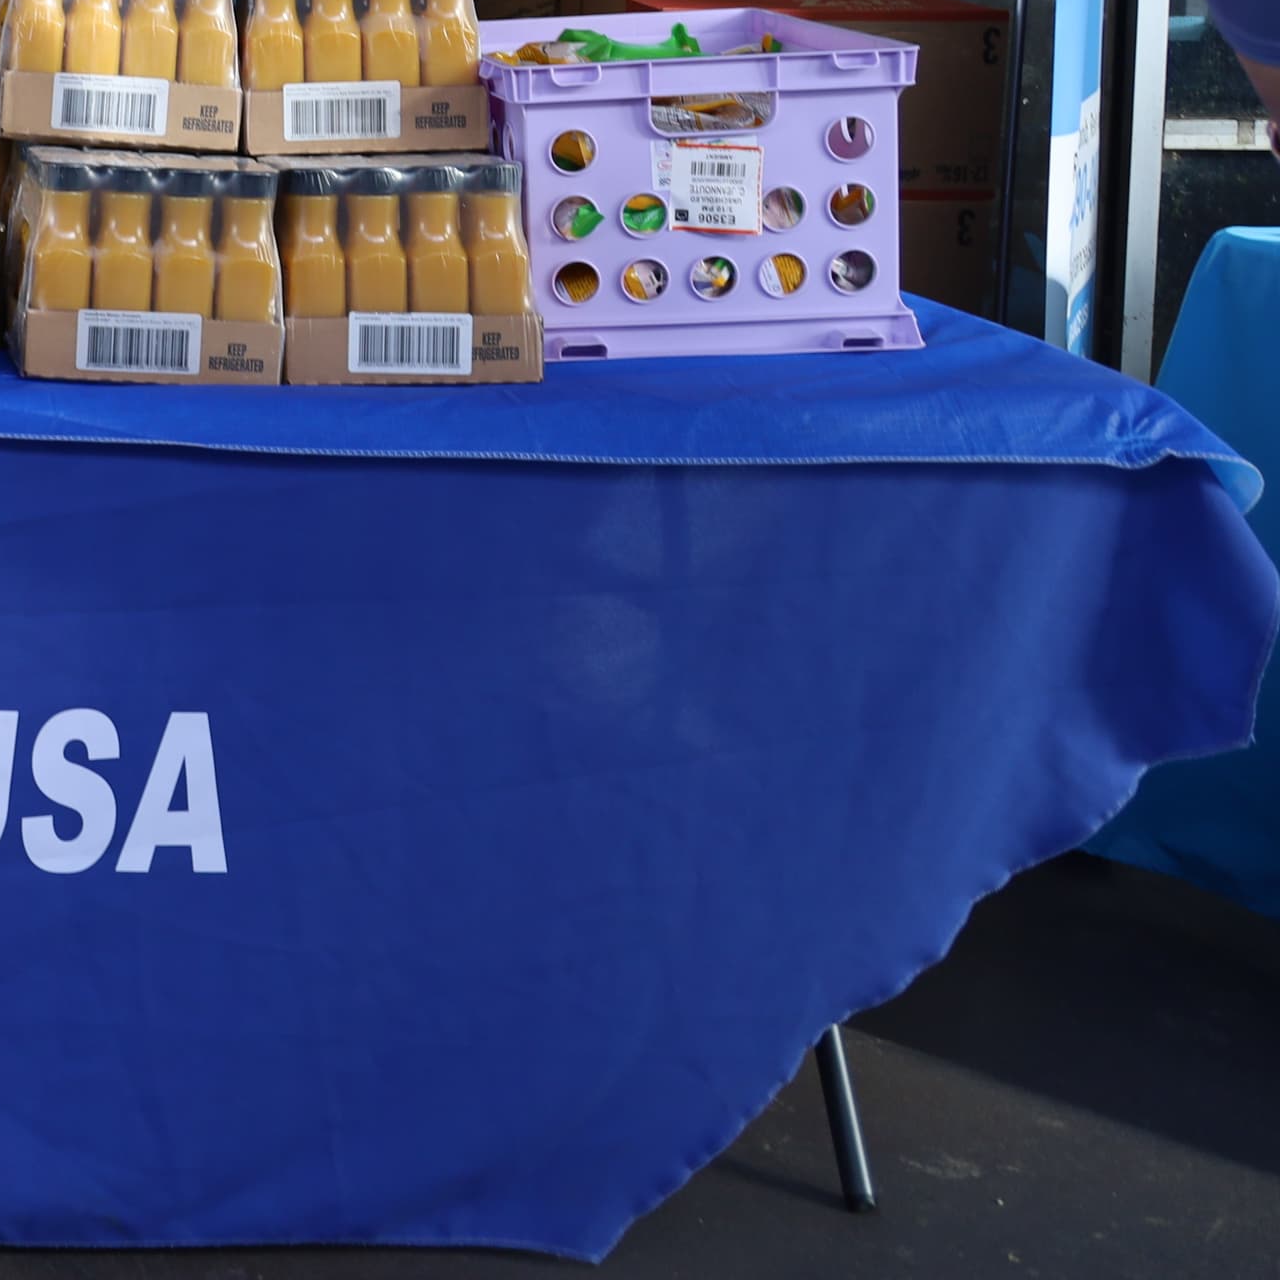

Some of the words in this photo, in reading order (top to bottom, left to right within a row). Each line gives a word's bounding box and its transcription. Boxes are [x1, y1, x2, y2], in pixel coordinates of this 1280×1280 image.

[199, 104, 218, 116] KEEP
[432, 101, 450, 115] KEEP
[182, 116, 234, 134] REFRIGERATED
[415, 115, 466, 129] REFRIGERATED
[698, 214, 736, 225] E3506
[482, 332, 501, 346] KEEP
[227, 342, 247, 356] KEEP
[208, 356, 264, 373] REFRIGERATED
